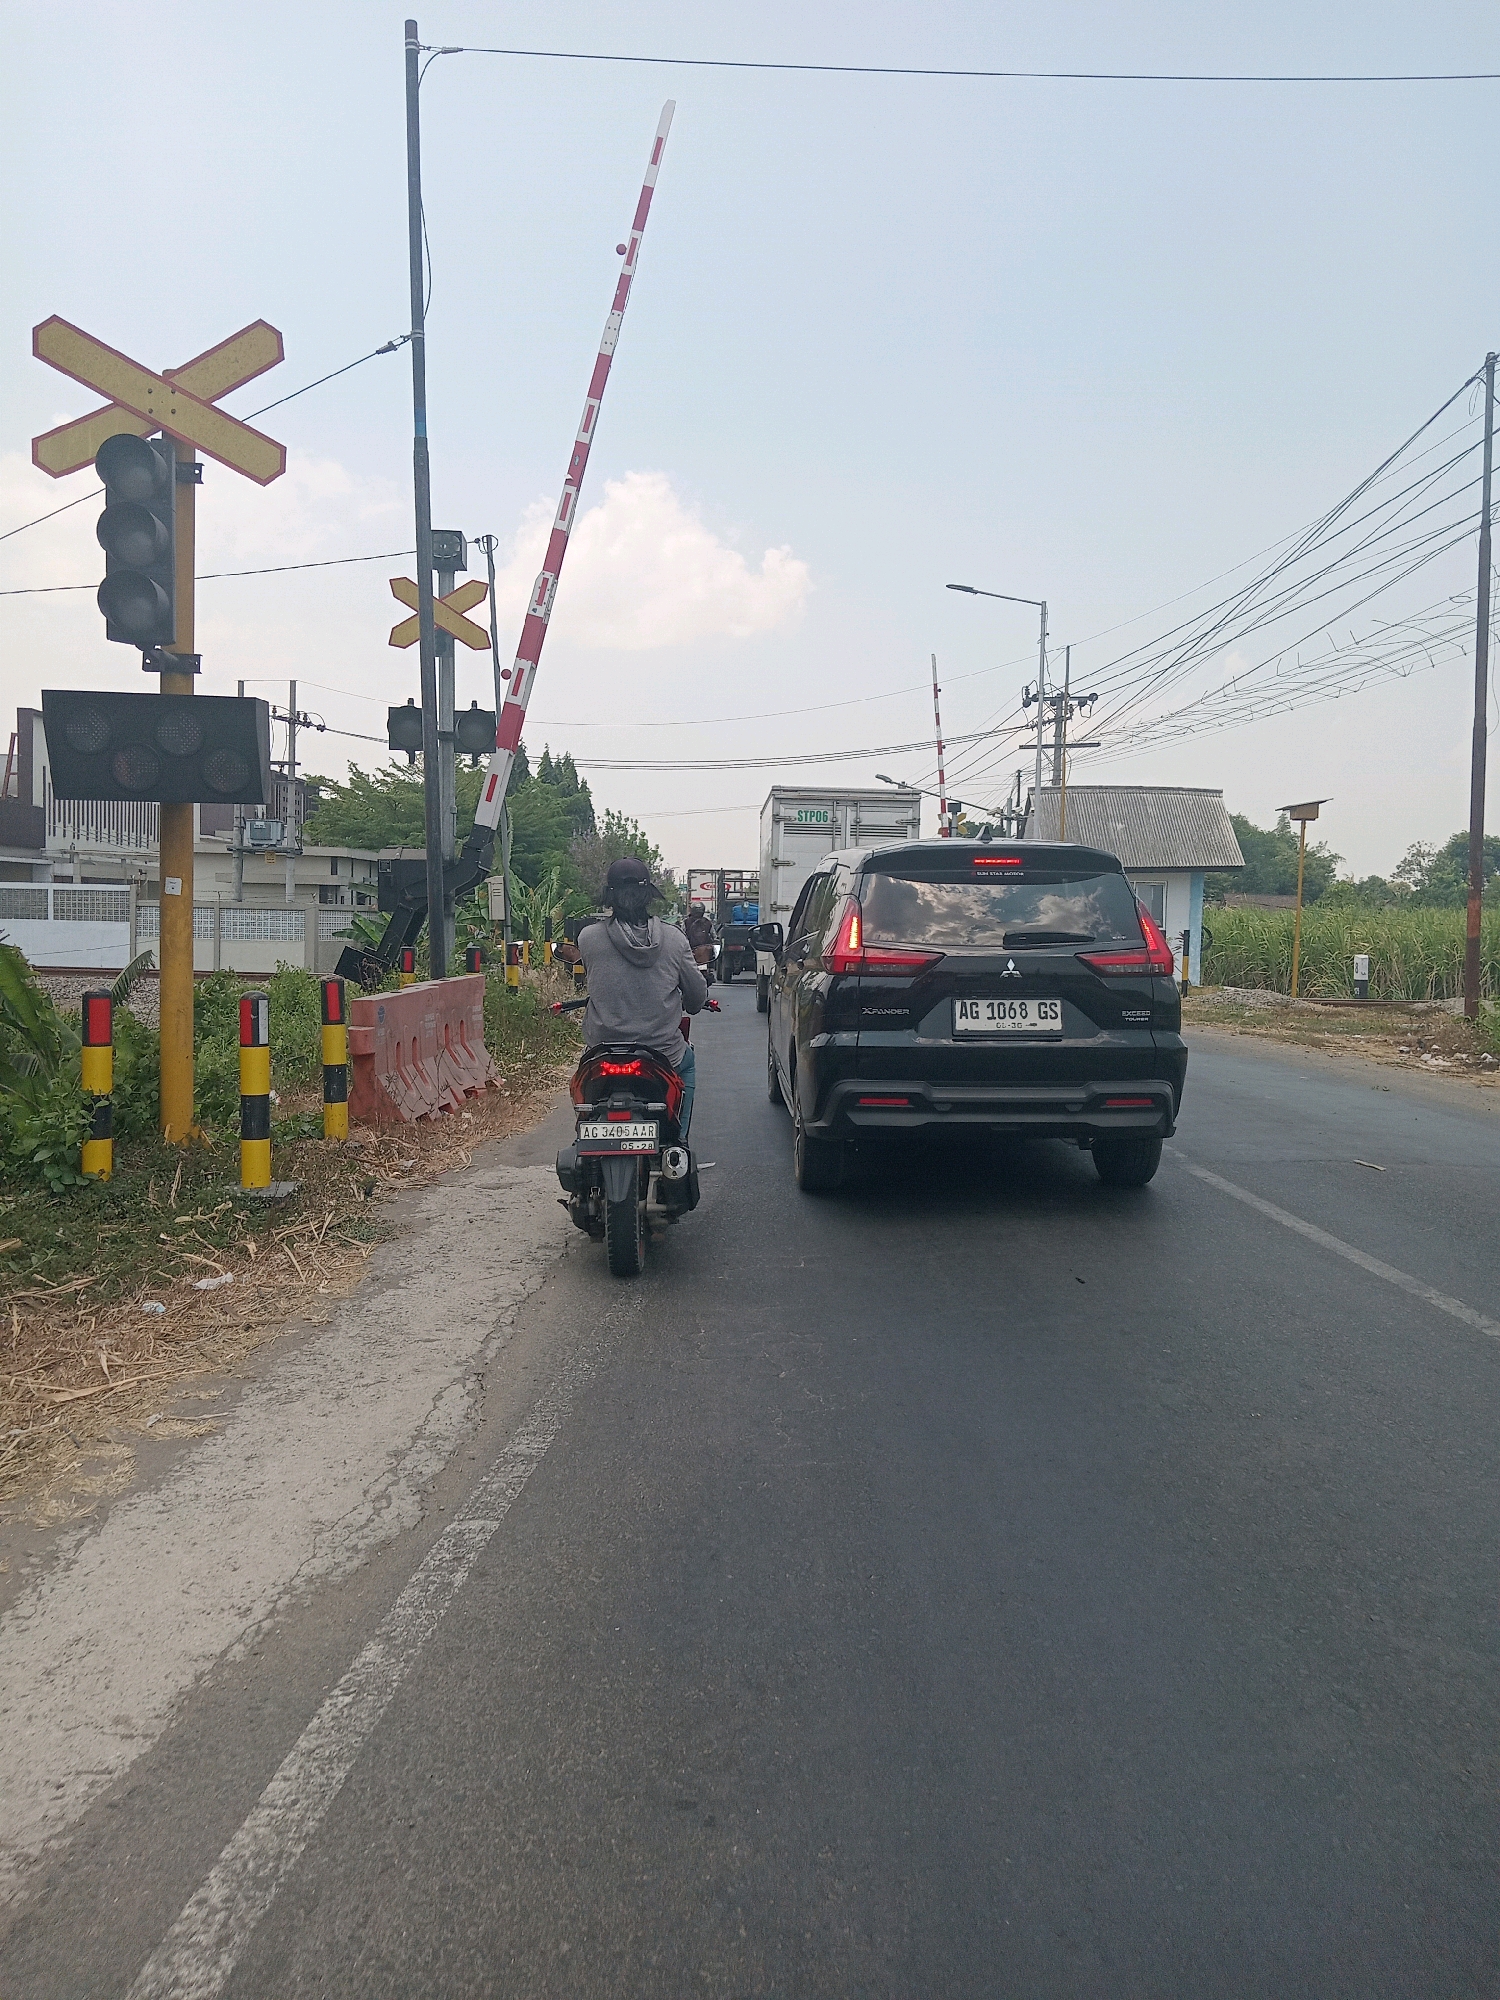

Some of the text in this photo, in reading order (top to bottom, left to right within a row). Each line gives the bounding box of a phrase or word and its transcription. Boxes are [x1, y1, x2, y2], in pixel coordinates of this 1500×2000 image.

[797, 809, 828, 822] STP06
[959, 1001, 1059, 1020] AG 1068 GS
[583, 1125, 655, 1138] AG 3405 AAR
